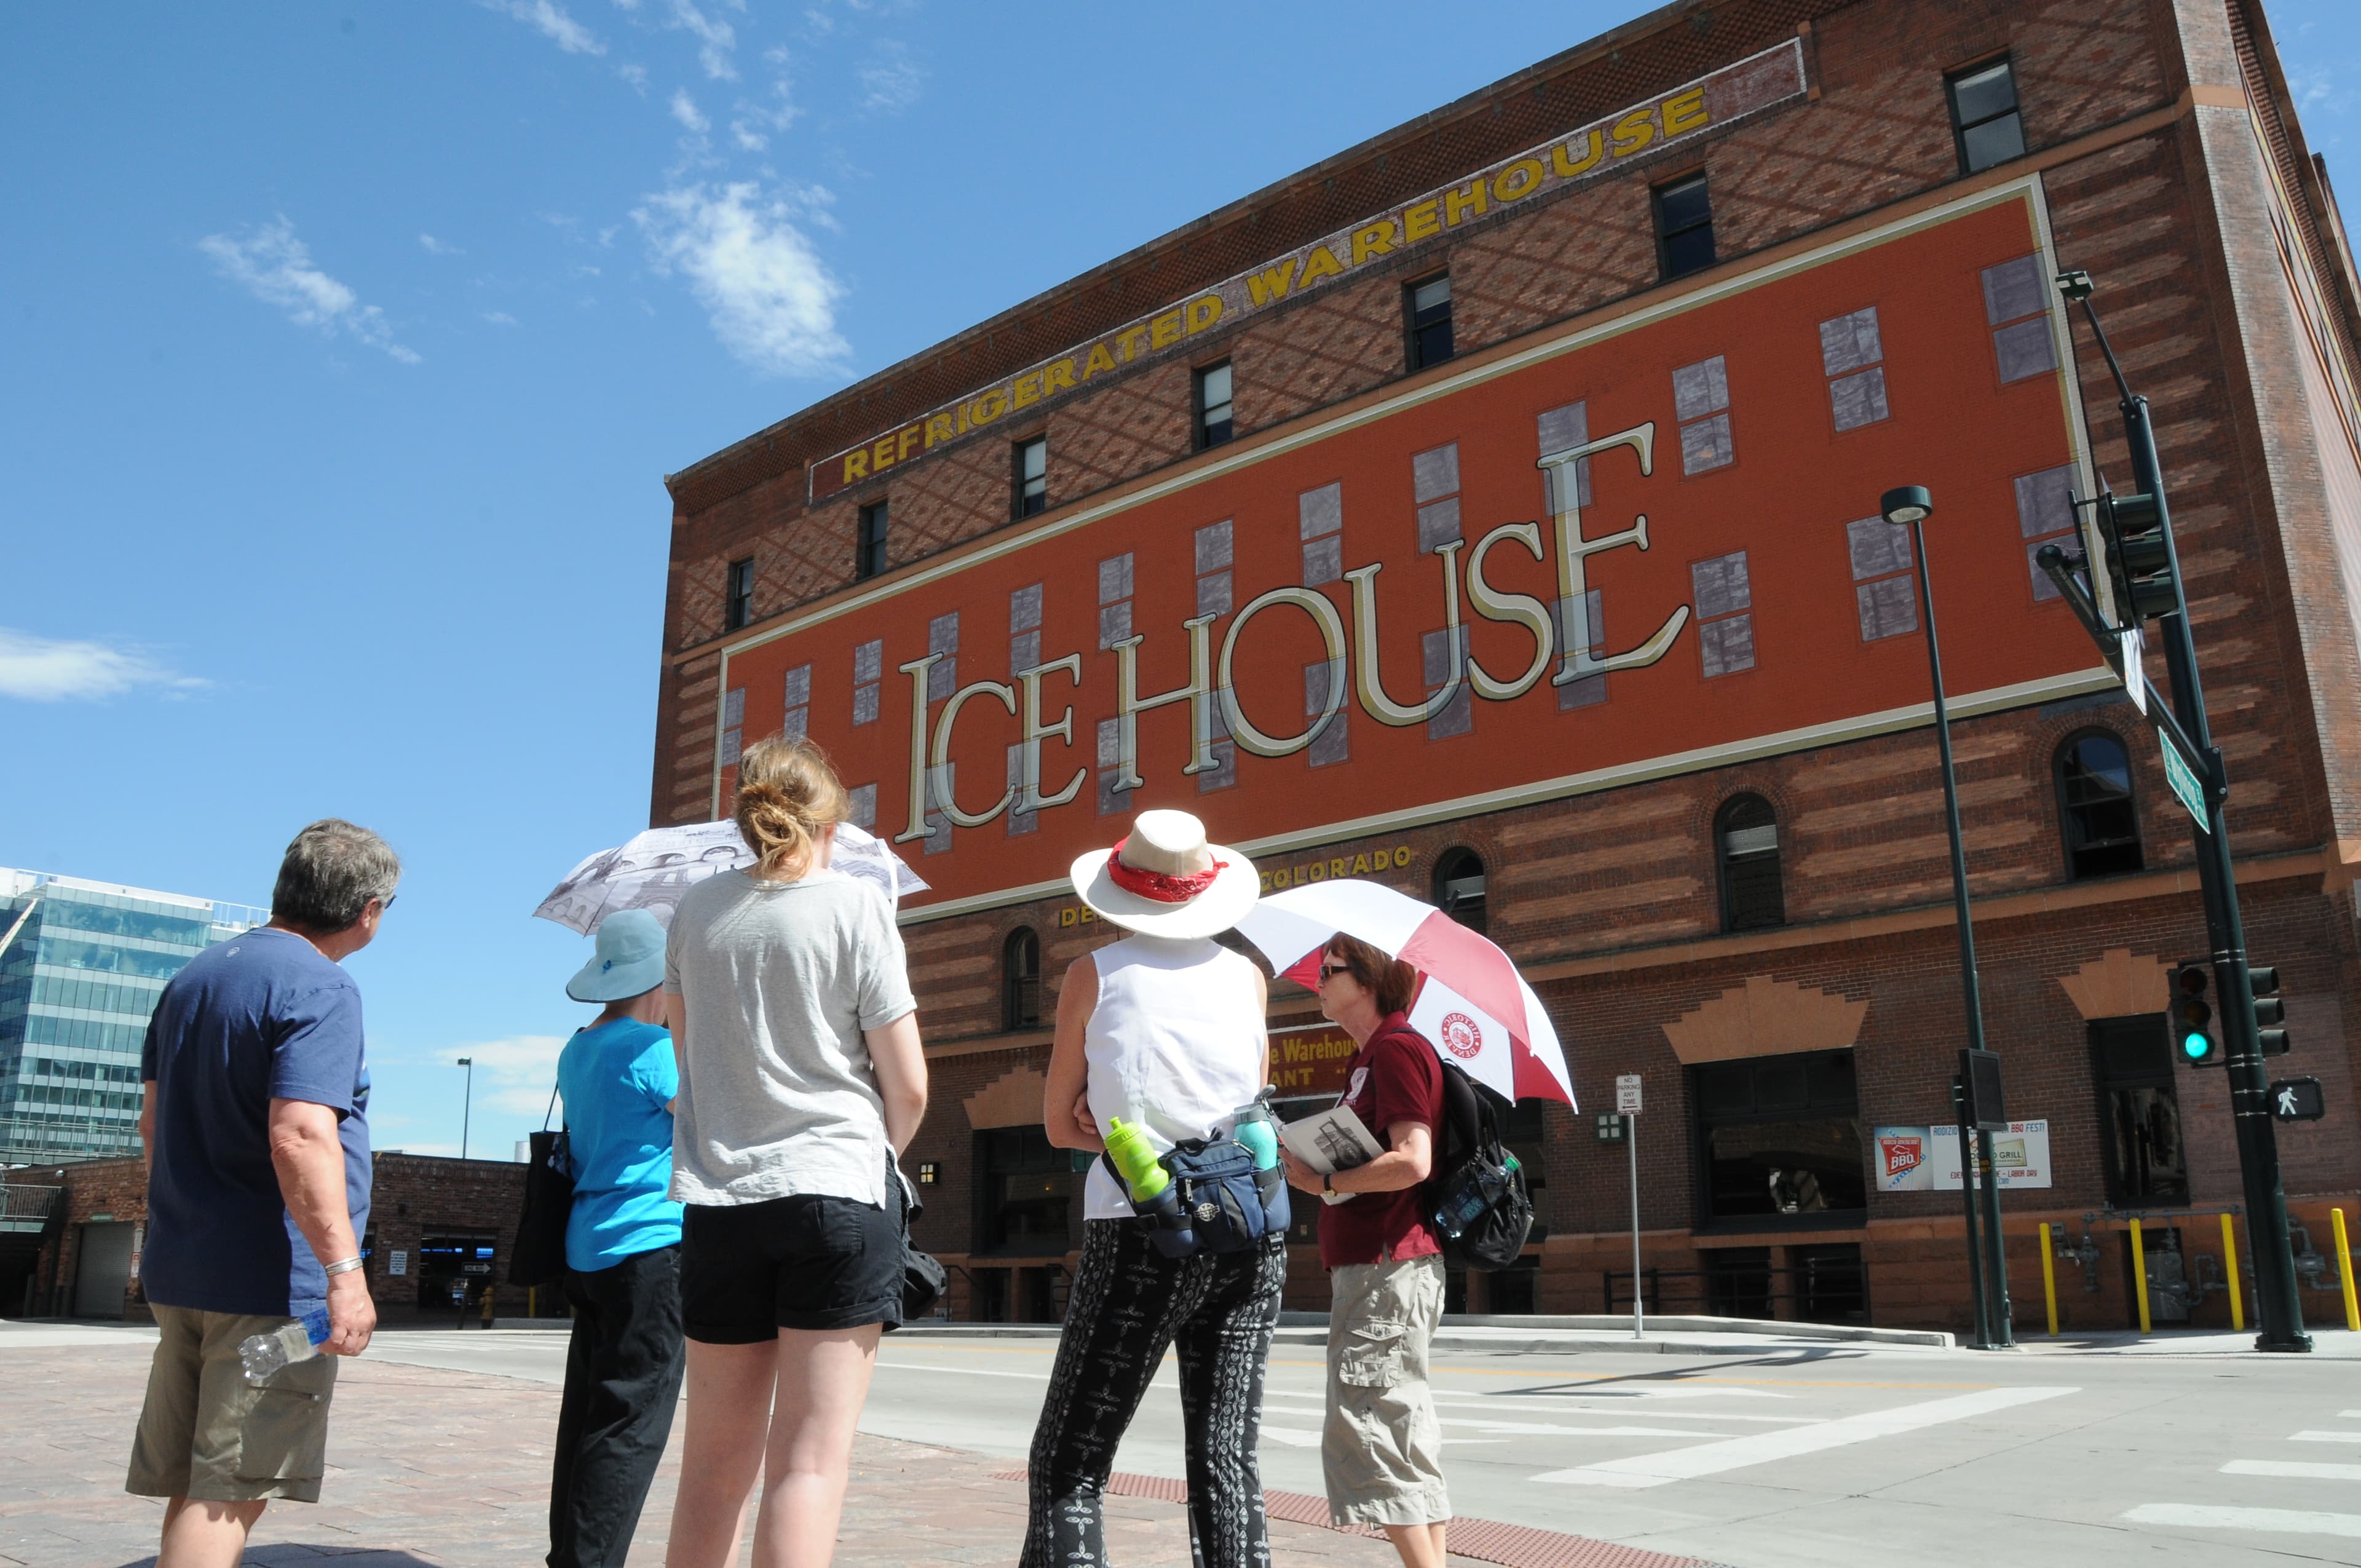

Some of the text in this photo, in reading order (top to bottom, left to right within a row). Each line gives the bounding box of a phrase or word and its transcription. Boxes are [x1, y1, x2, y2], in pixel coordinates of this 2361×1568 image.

[843, 86, 1710, 485] REFRIGERATED WAREHOUSE
[1260, 845, 1412, 892] COLORADO
[1283, 1034, 1358, 1064] Warehou
[1891, 1154, 1916, 1170] BBQ
